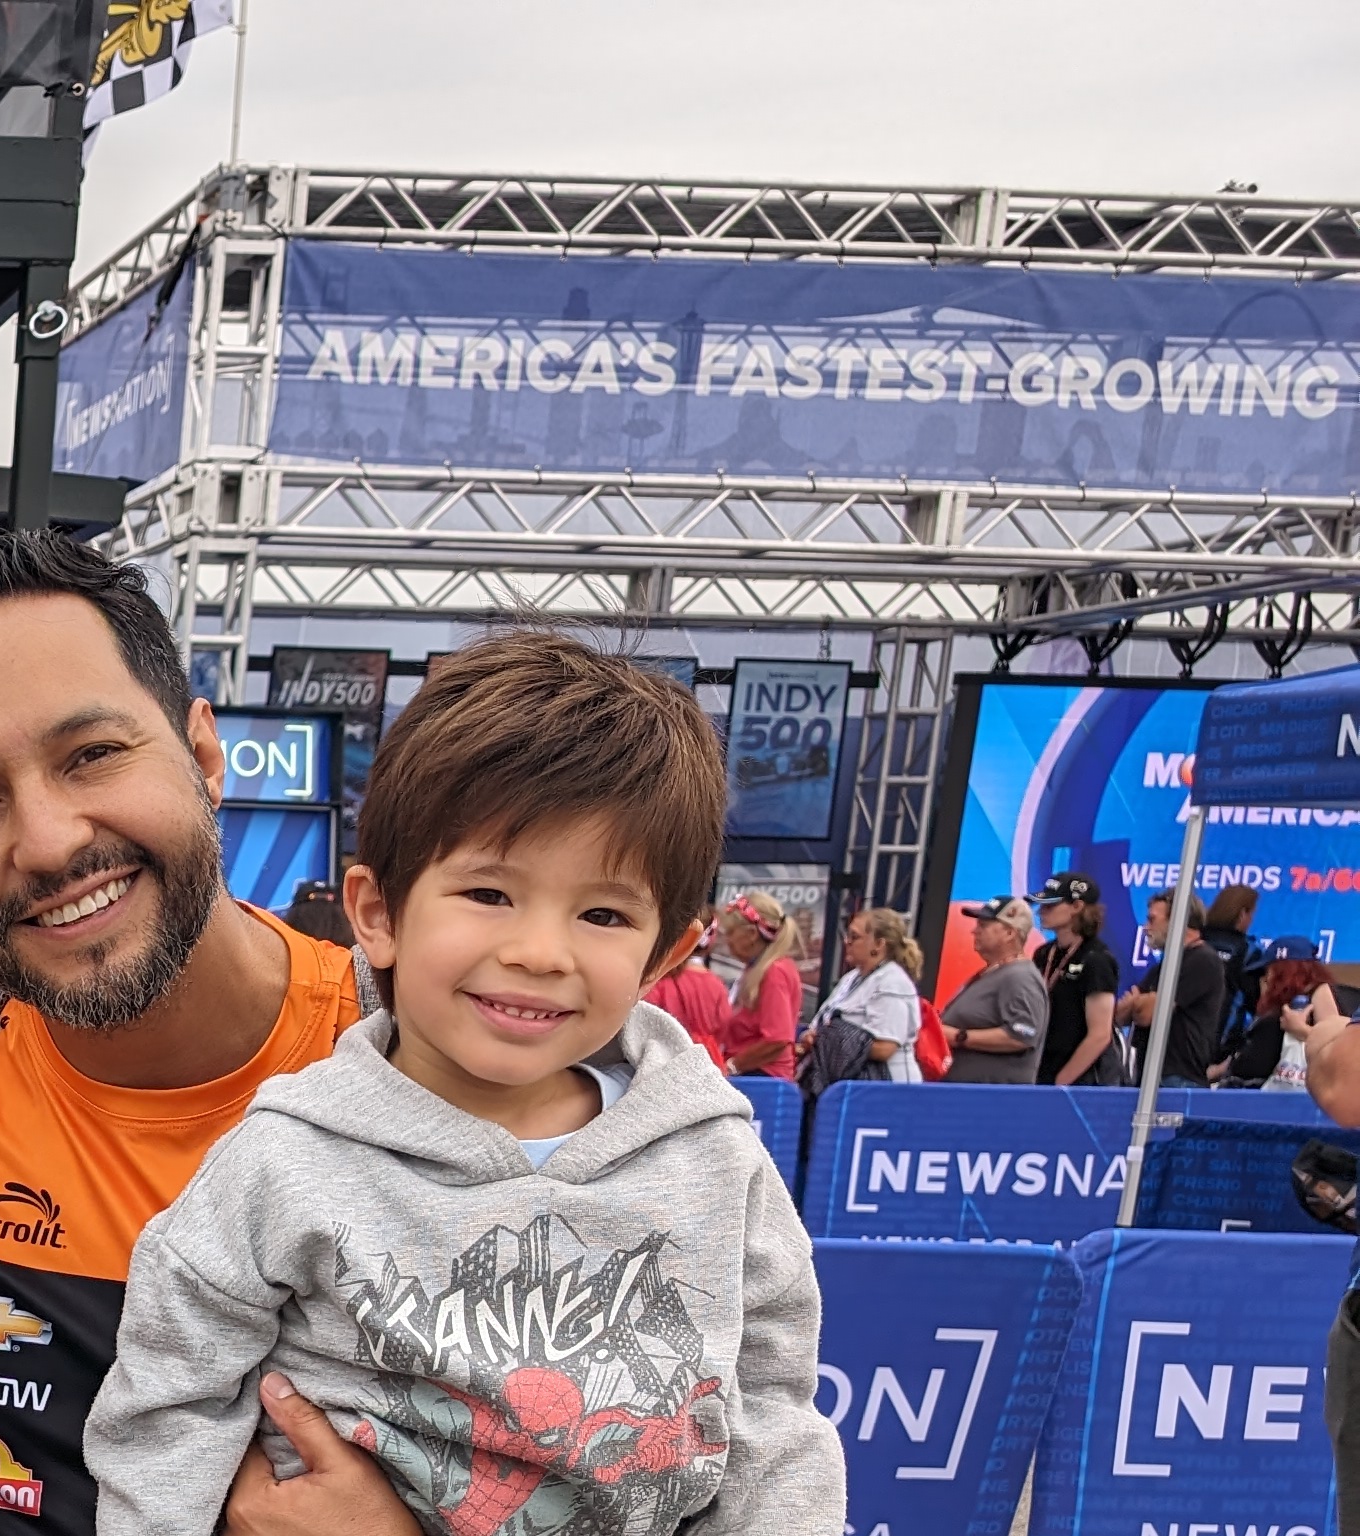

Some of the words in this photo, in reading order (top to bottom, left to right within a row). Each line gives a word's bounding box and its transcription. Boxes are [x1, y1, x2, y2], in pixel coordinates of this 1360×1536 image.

[307, 329, 678, 396] AMERICA'S
[693, 331, 1342, 421] FASTEST-GROWING
[743, 682, 837, 713] INDY
[737, 716, 833, 751] 500
